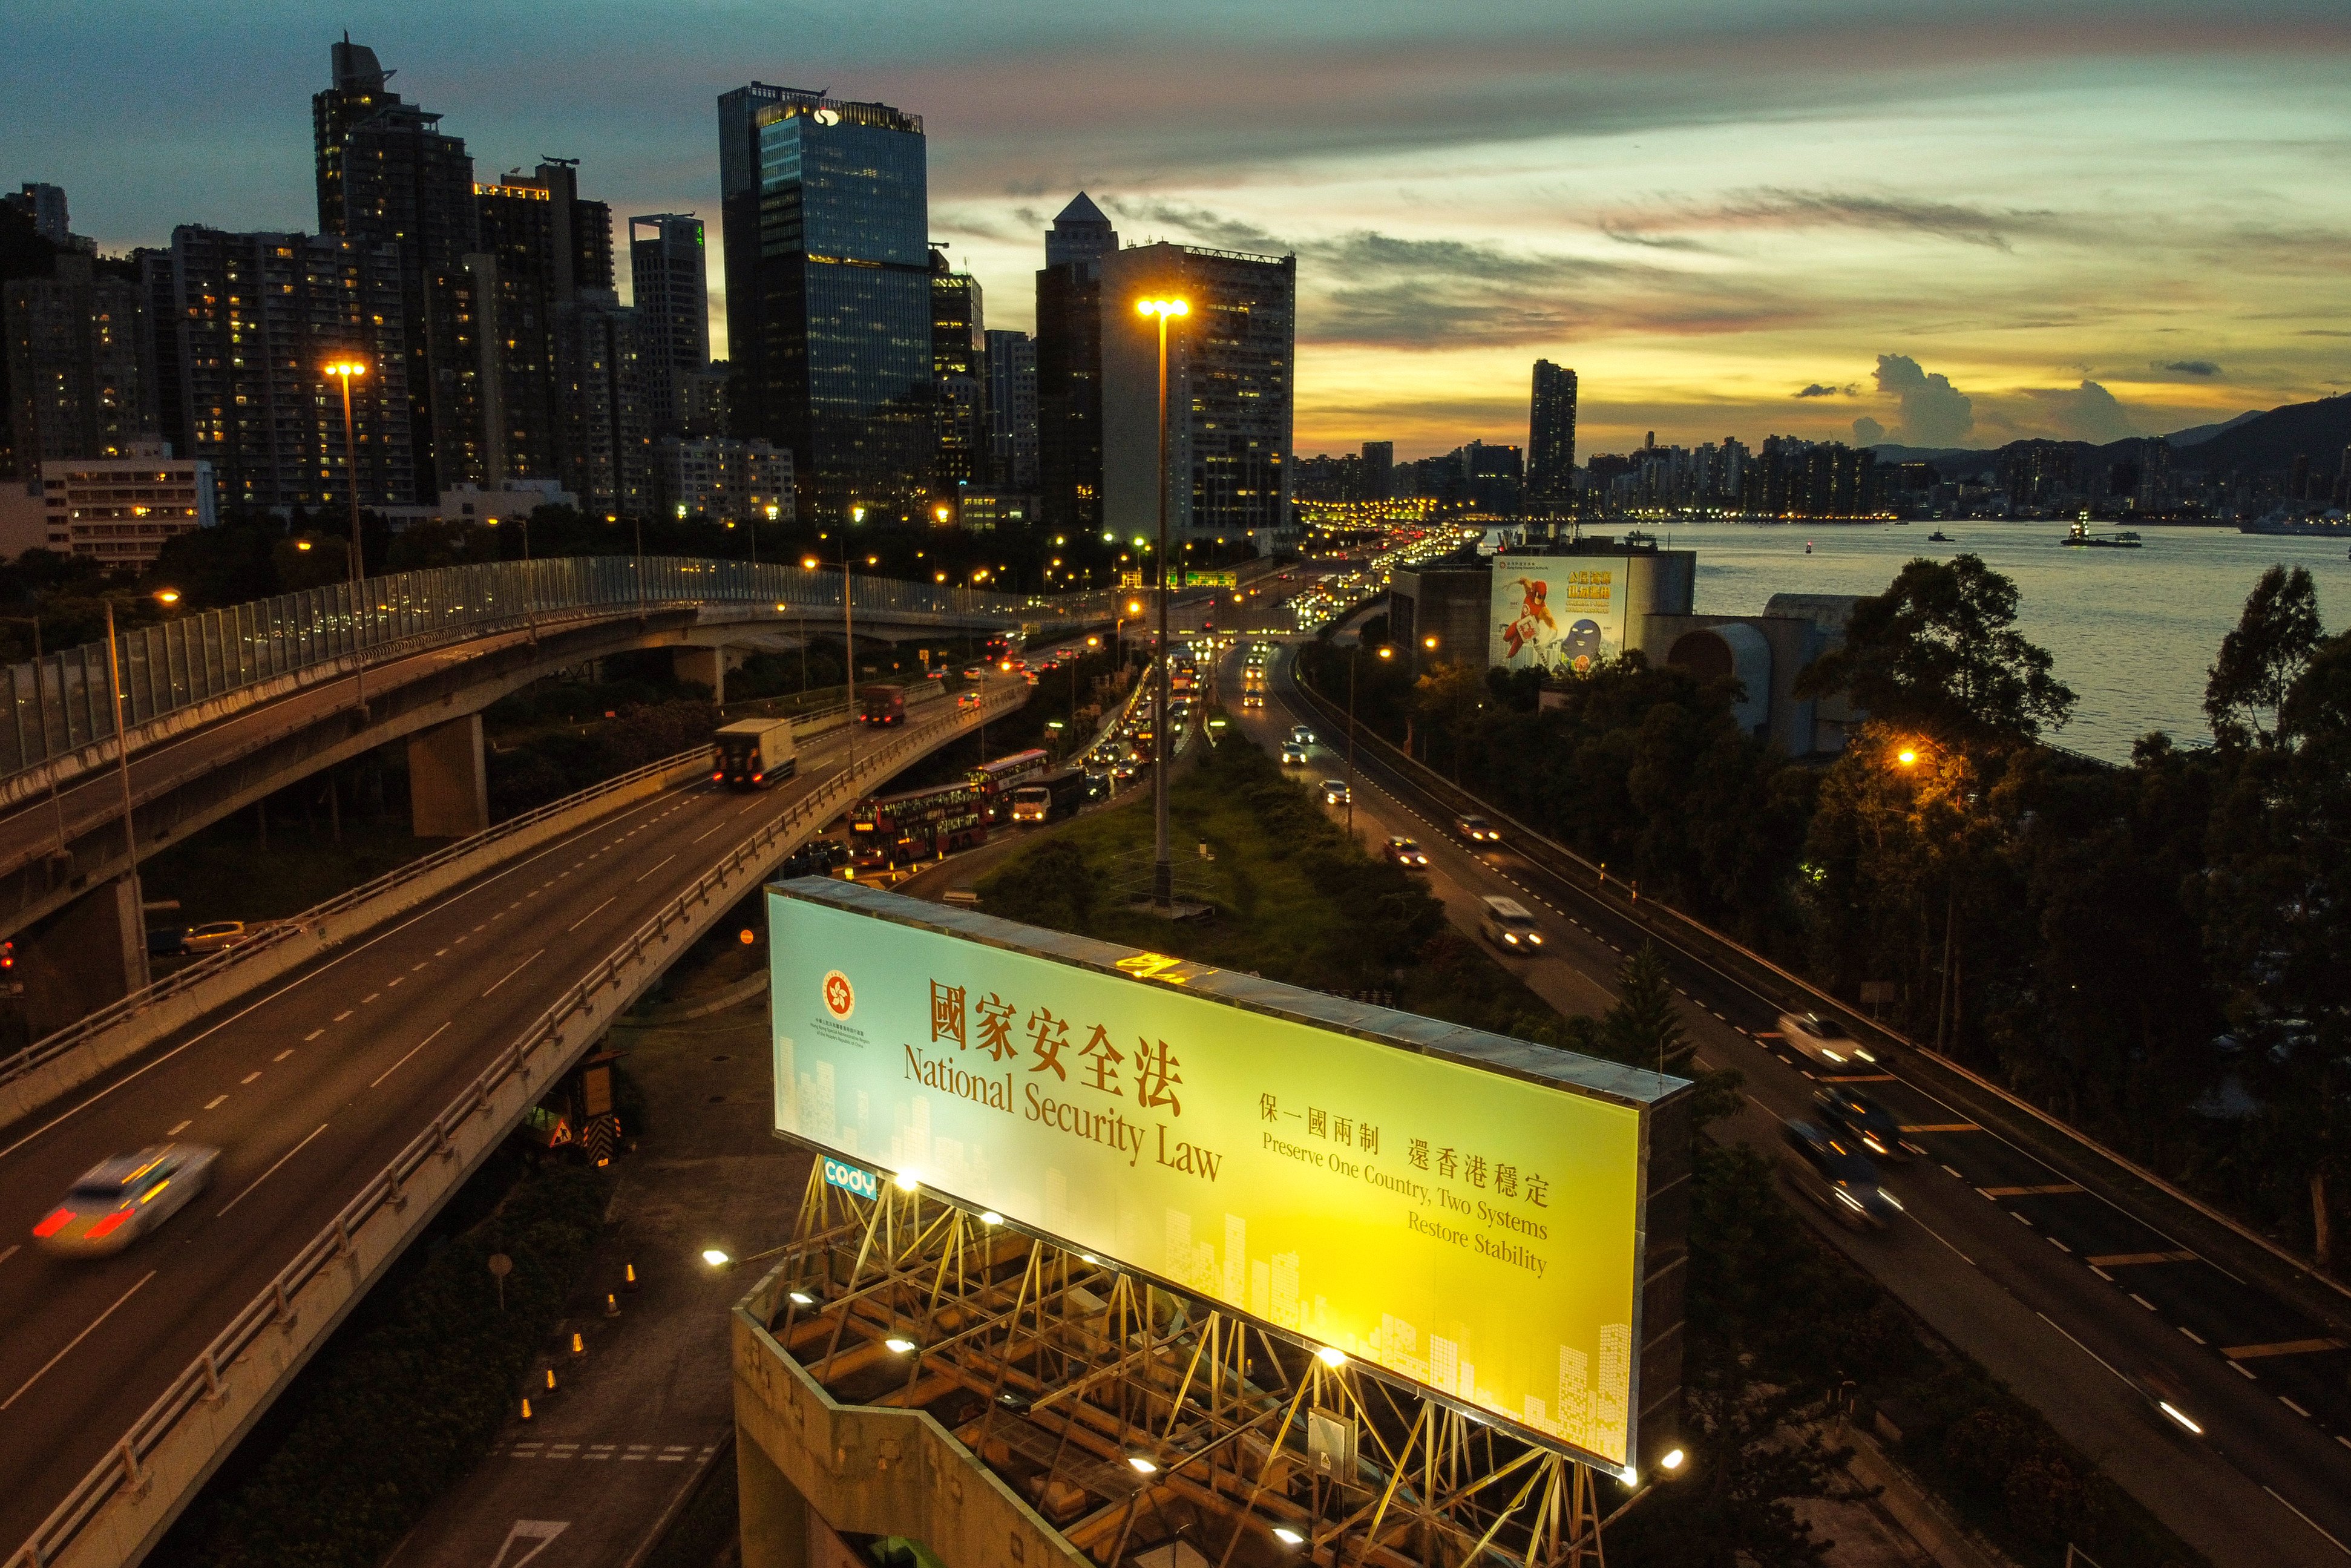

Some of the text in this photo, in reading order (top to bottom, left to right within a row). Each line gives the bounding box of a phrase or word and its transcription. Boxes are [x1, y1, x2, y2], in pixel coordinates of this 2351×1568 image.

[930, 977, 1183, 1117] 國家安全法
[903, 1043, 1222, 1183] National Security Law
[1259, 1092, 1549, 1209] 保一國兩制 還香港穩定
[825, 1161, 875, 1196] cody
[1263, 1132, 1547, 1240] Preserve One Country, Two Systems
[1408, 1210, 1547, 1279] Restore Stability
